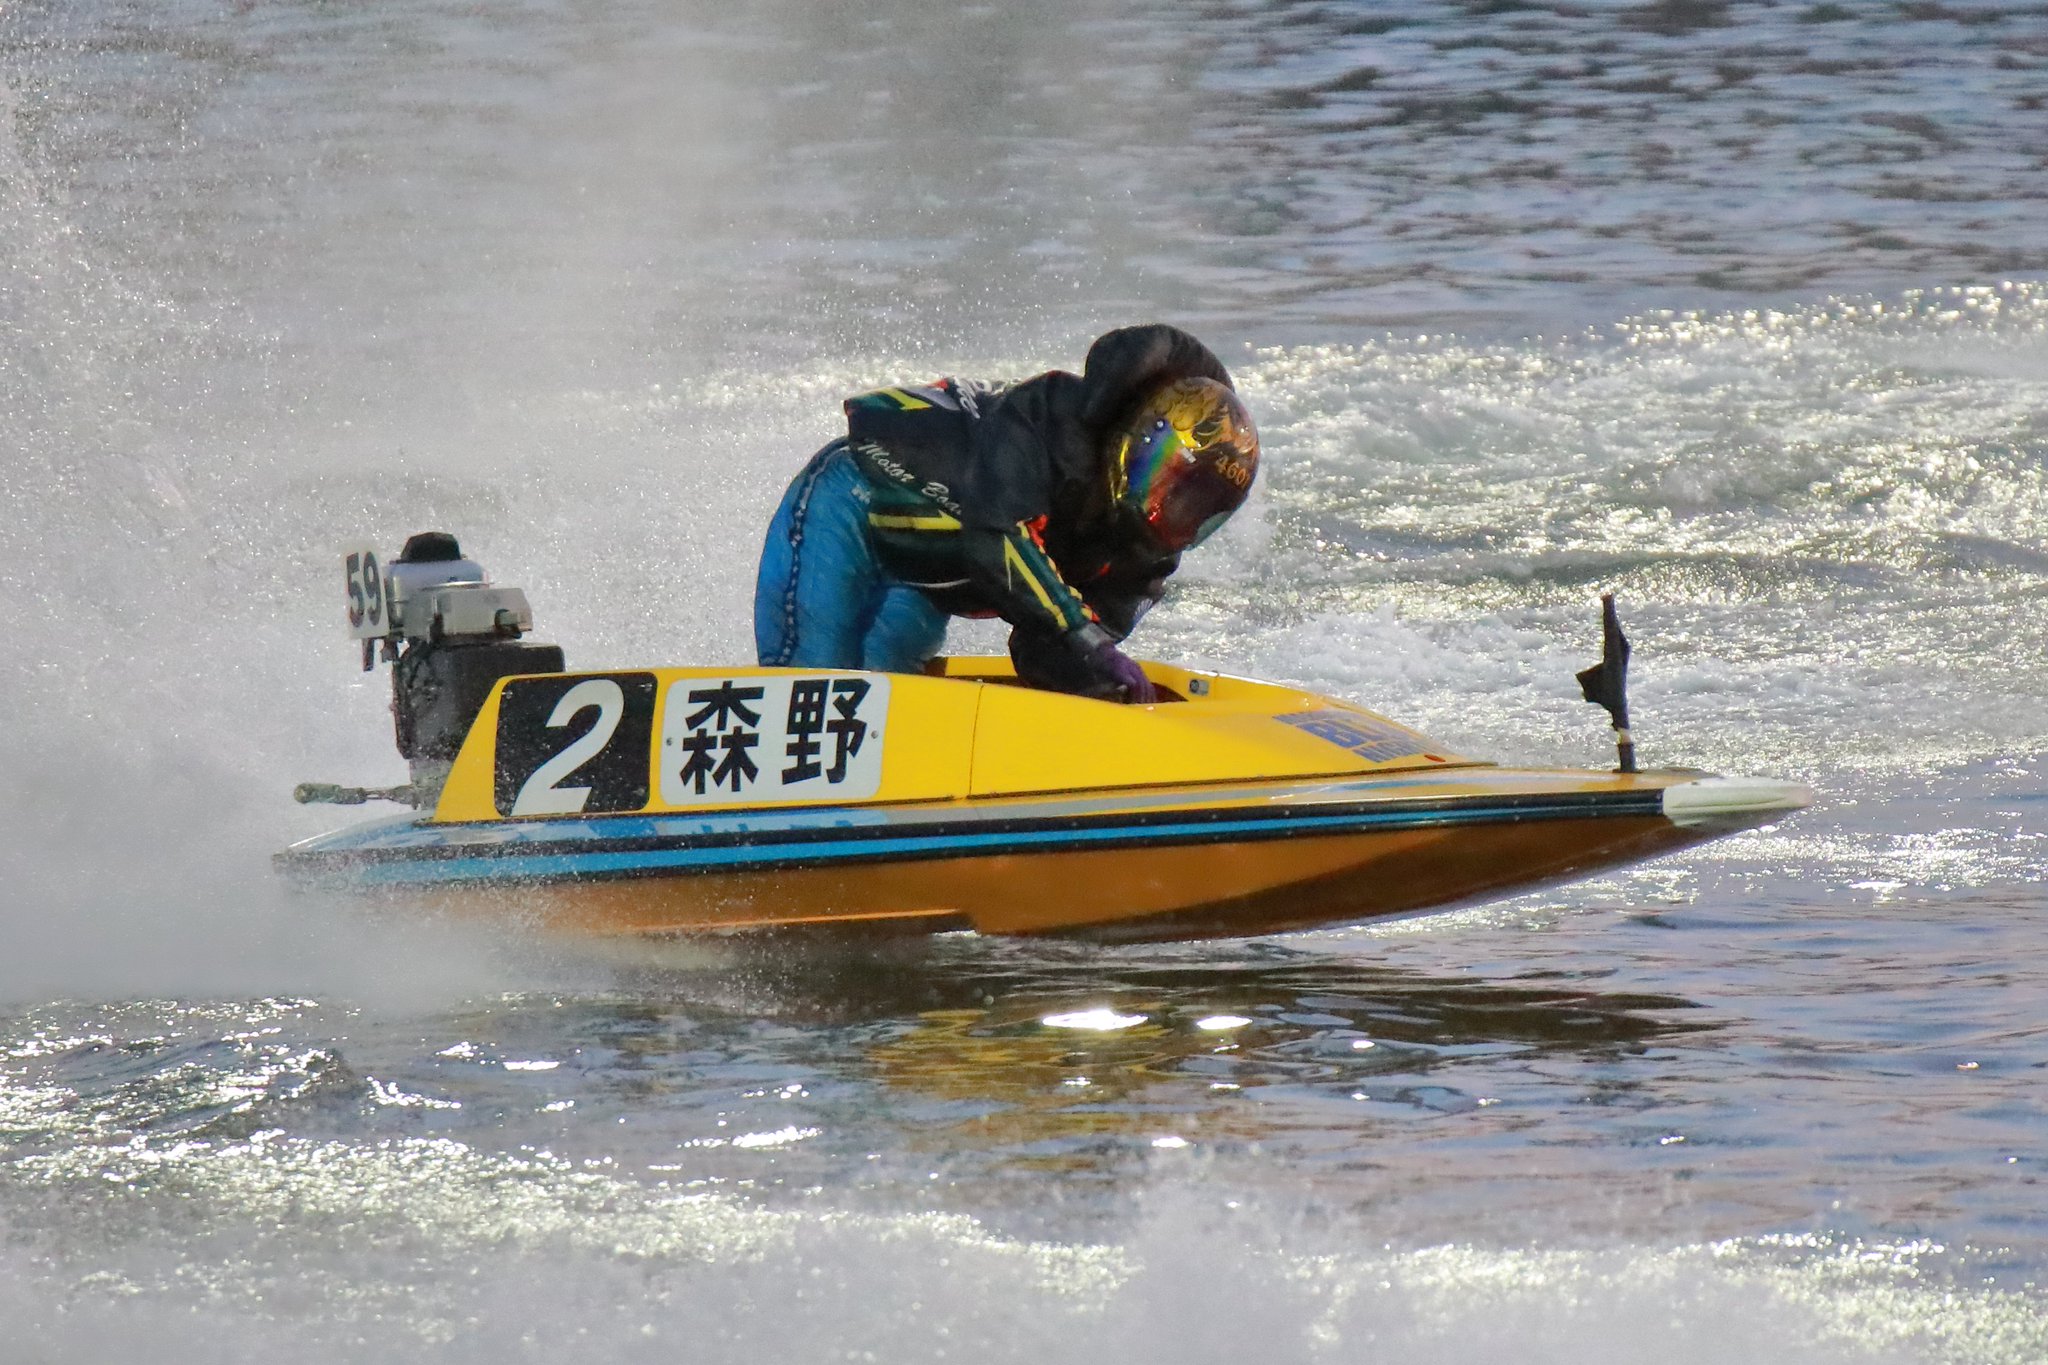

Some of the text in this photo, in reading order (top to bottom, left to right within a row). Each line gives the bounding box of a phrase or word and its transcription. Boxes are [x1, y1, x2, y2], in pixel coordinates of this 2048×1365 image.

[857, 439, 915, 482] Motor
[346, 551, 381, 628] 59
[510, 678, 625, 817] 2
[679, 678, 872, 795] 森野
